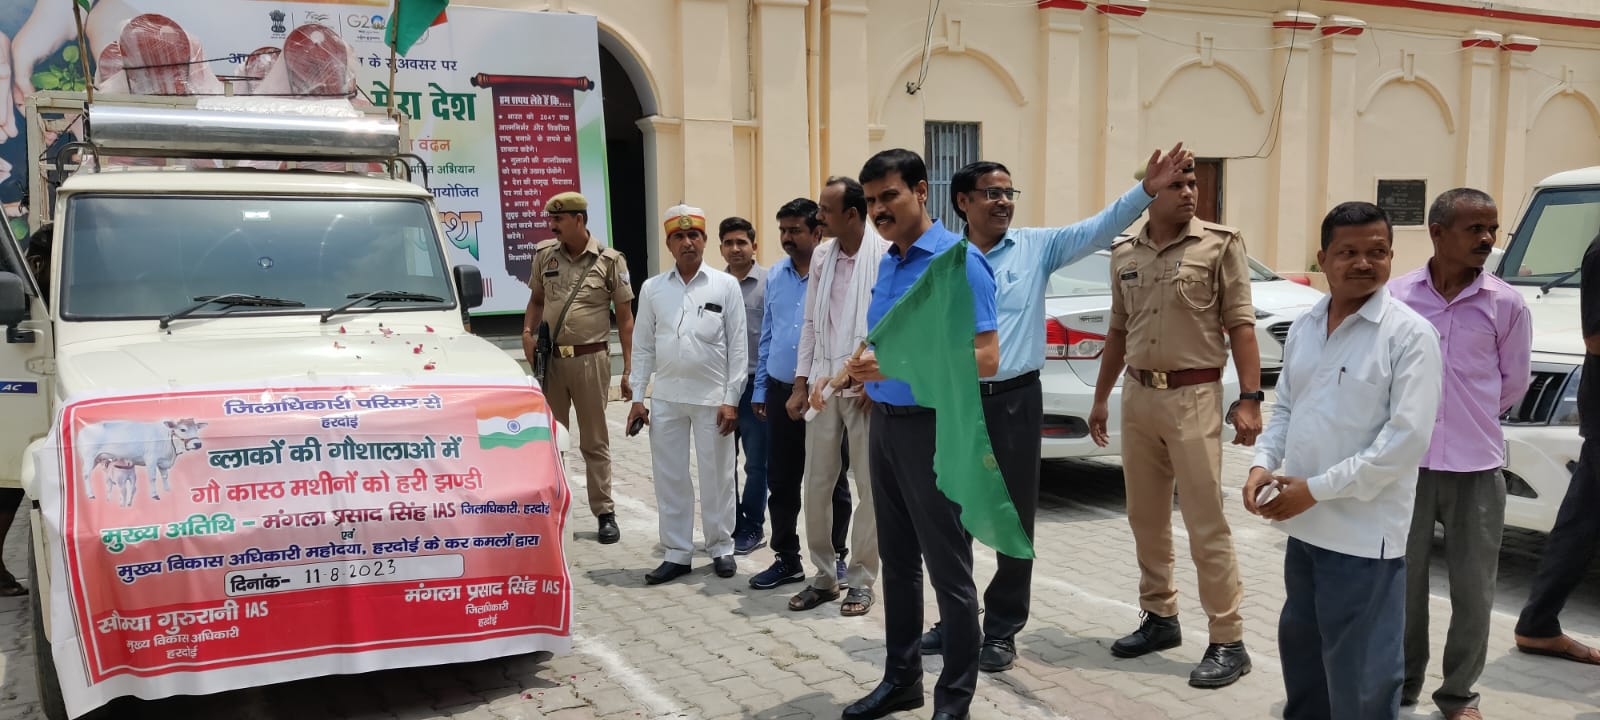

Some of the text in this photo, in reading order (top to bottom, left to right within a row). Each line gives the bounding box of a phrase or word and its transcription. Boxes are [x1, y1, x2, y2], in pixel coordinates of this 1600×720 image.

[369, 53, 381, 68] के
[442, 60, 457, 71] पर
[370, 81, 477, 121] मेरा देश
[418, 136, 451, 151] वंदन
[437, 163, 475, 174] अभियान
[224, 394, 441, 414] जिलाधिकारी परिसर से
[321, 415, 358, 428] हरदोई
[209, 435, 462, 469] ब्लाकों की गौशालाओ में
[191, 466, 482, 503] गौ कास्ठ मशीनों को हरी झण्डी
[101, 524, 160, 552] मुख्य
[165, 514, 235, 538] अतिथि
[262, 509, 326, 528] मंगला
[331, 508, 383, 526] प्रसाद
[389, 502, 427, 521] सिंह
[433, 503, 456, 518] IAS
[341, 528, 355, 540] एवं
[117, 561, 162, 583] मुख्य
[167, 555, 224, 571] विकास
[229, 545, 301, 565] अधिकारी
[372, 536, 420, 553] हरदोई
[424, 536, 440, 550] के
[445, 538, 470, 549] कर
[474, 533, 514, 547] कमलों
[515, 535, 540, 547] द्वारा
[405, 575, 560, 602] मंगला प्रसाद सिंह IAS
[97, 600, 269, 634] सौम्या गुरुरानी IAS
[126, 626, 239, 653] मुख्य विकास अधिकारी
[167, 645, 198, 658] हरदोई
